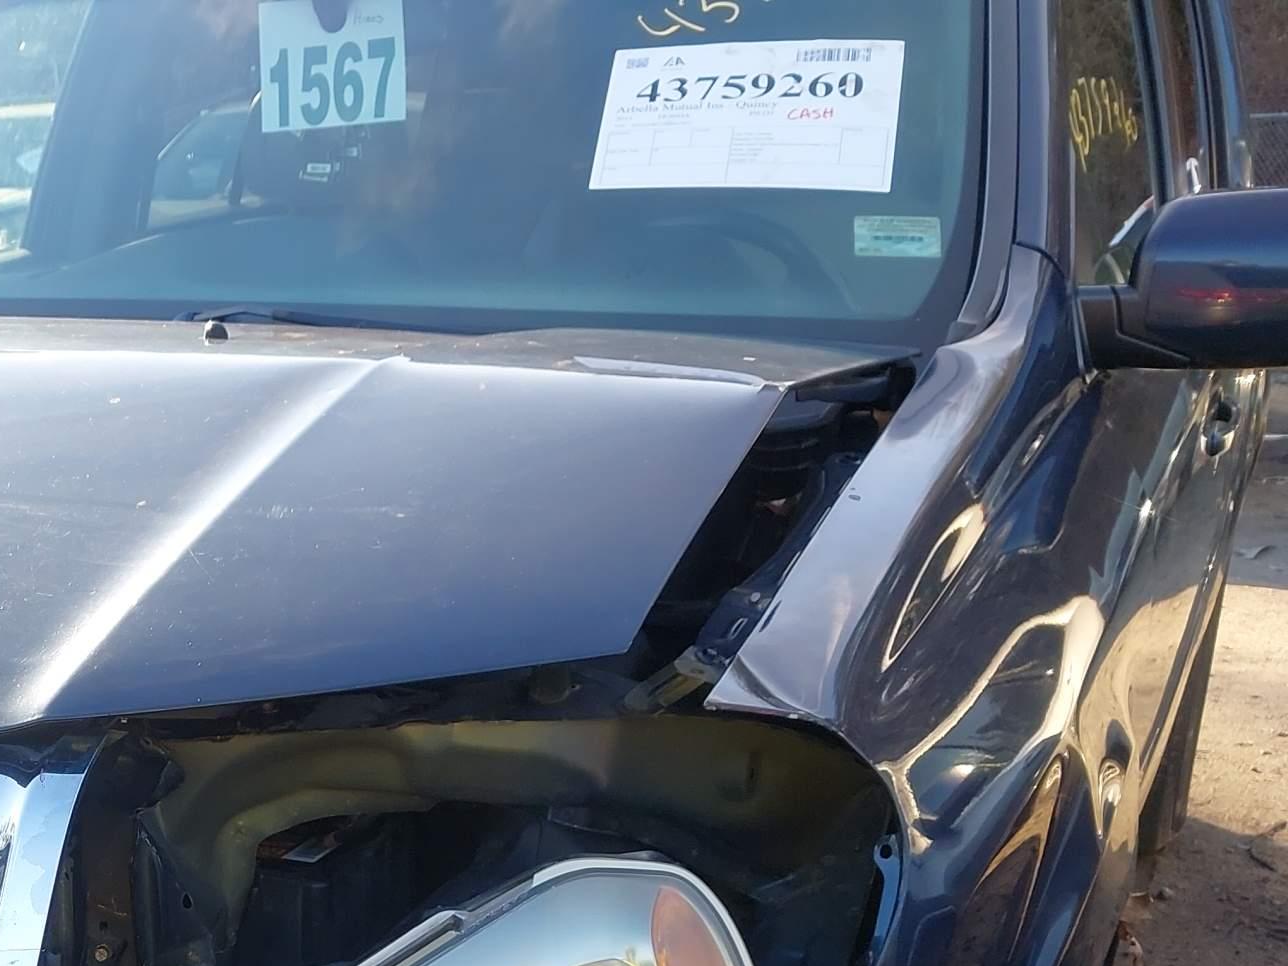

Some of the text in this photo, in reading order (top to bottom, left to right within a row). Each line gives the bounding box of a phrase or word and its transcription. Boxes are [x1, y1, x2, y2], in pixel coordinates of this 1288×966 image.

[270, 37, 395, 128] 1567
[636, 72, 863, 102] 43759260
[787, 106, 834, 120] CASH
